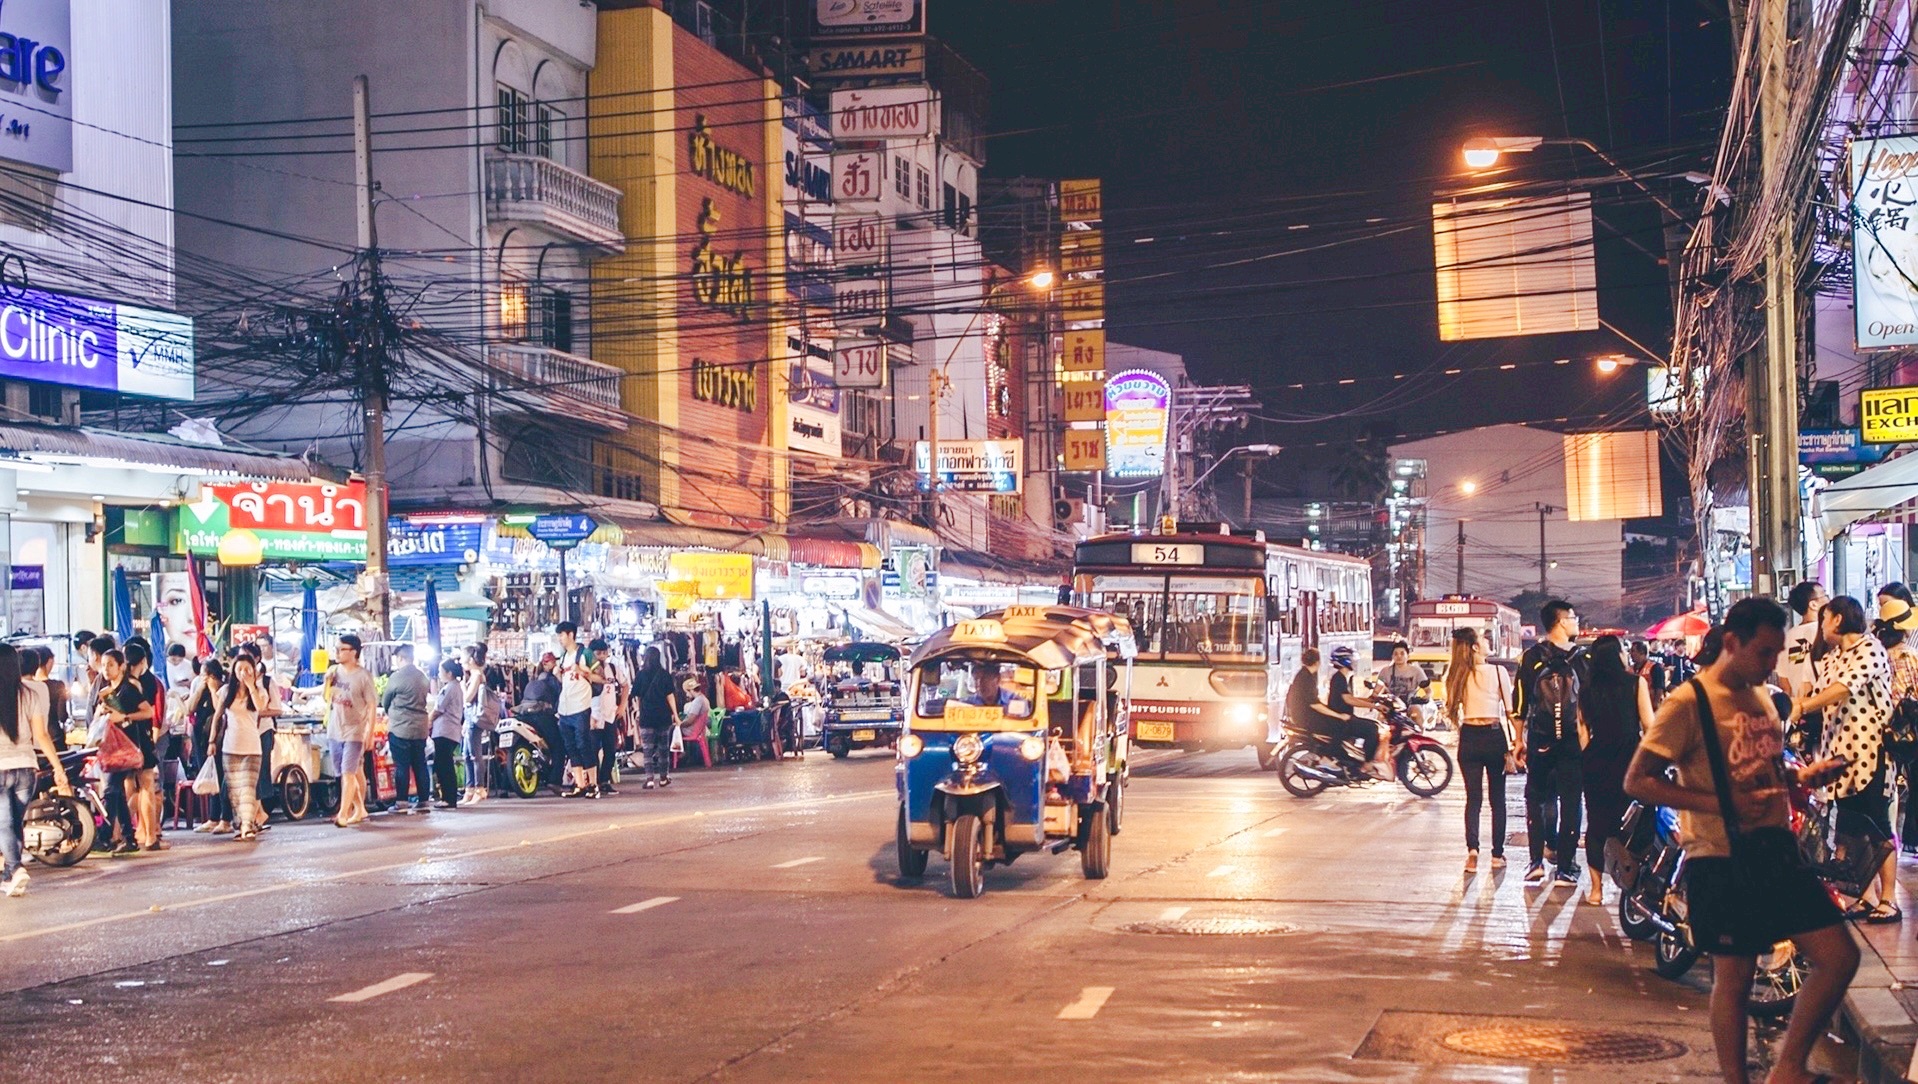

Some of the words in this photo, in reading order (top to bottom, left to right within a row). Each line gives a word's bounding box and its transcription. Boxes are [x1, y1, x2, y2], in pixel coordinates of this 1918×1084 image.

[821, 47, 912, 72] SAMART
[840, 93, 919, 132] ห้างทอง
[0, 304, 99, 369] Clinic
[1868, 321, 1915, 340] Open
[1867, 416, 1918, 430] EXCH
[232, 482, 363, 528] จำนำ
[579, 518, 588, 531] 4
[1154, 546, 1180, 562] 54
[1011, 607, 1036, 617] TAXI
[963, 624, 994, 635] TAXI
[1128, 705, 1201, 715] MITSUBISHI
